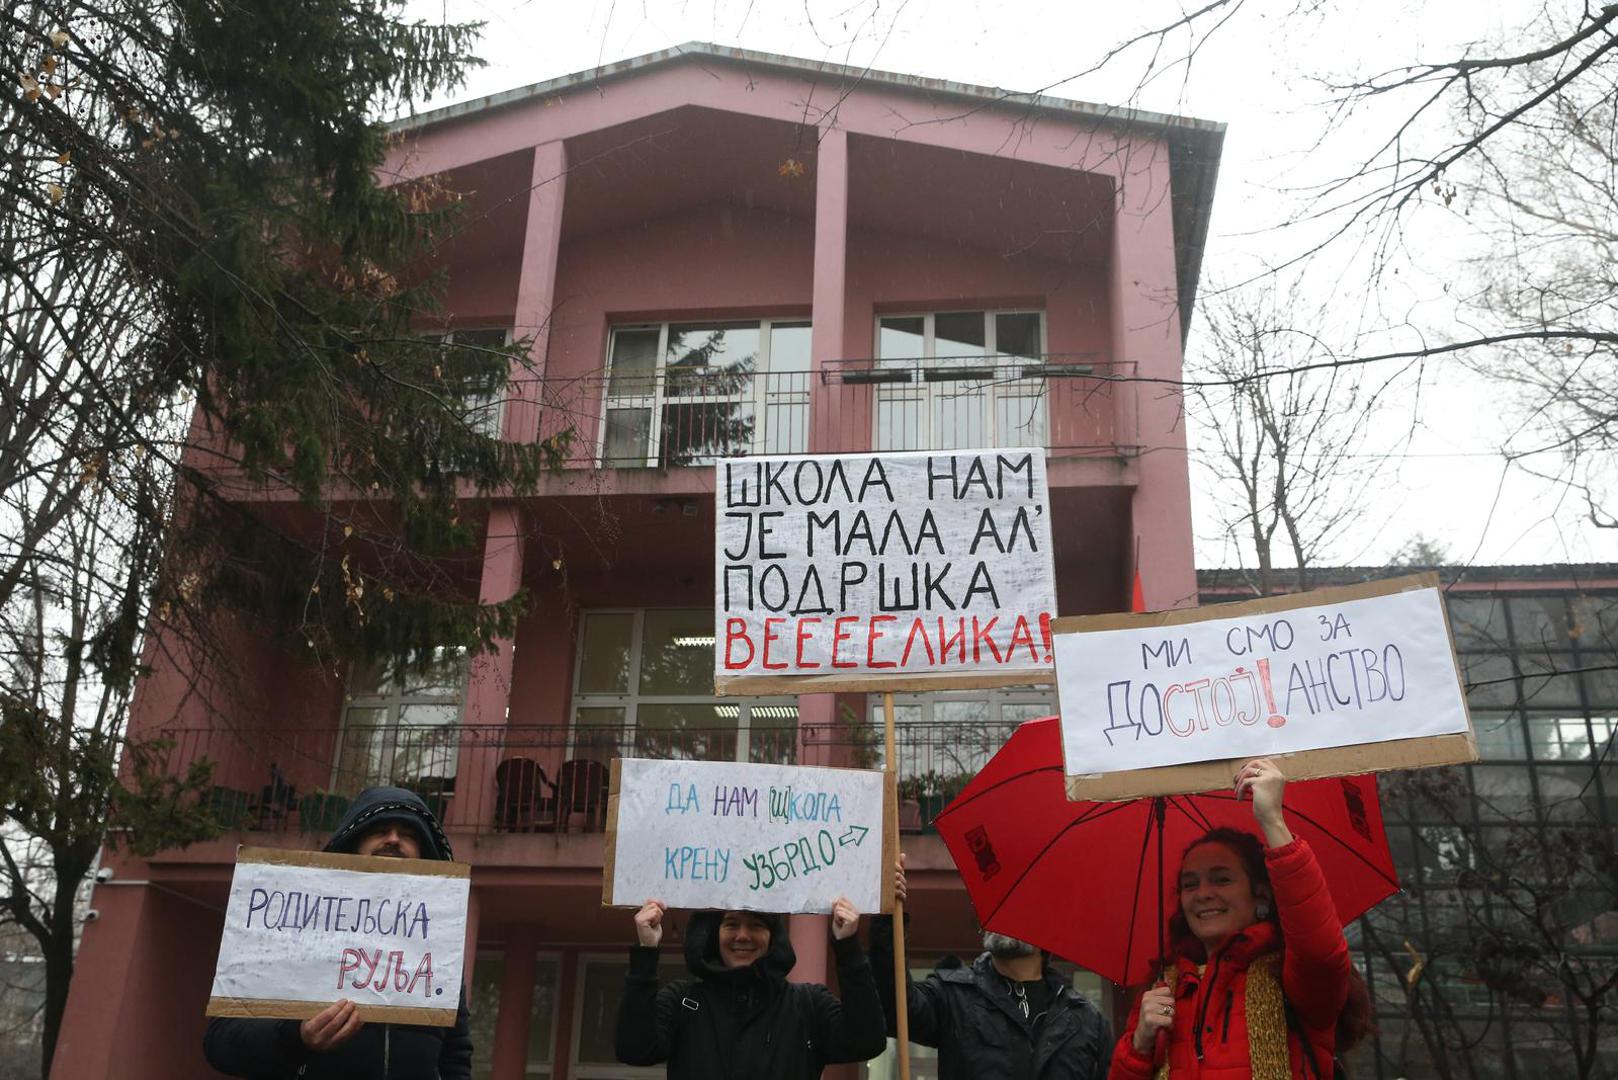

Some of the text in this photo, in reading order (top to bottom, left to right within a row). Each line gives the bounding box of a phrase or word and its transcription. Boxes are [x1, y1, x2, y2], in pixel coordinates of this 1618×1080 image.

[726, 453, 1034, 508] ШКОЛА НАМ
[724, 511, 787, 562] ЈЕ
[807, 507, 945, 557] МАЛА
[724, 561, 1000, 616] ПОДРШКА
[724, 612, 1053, 670] ВЕЕЕЕЛИКА!
[1141, 613, 1353, 670] МИ СМО ЗА
[665, 783, 700, 815] ДА
[713, 785, 758, 817] НАМ
[665, 829, 836, 890] КРЕНУ УЗБРДО
[246, 888, 431, 939] РОДИТЕЉСКА
[337, 948, 443, 998] РУЉА.
